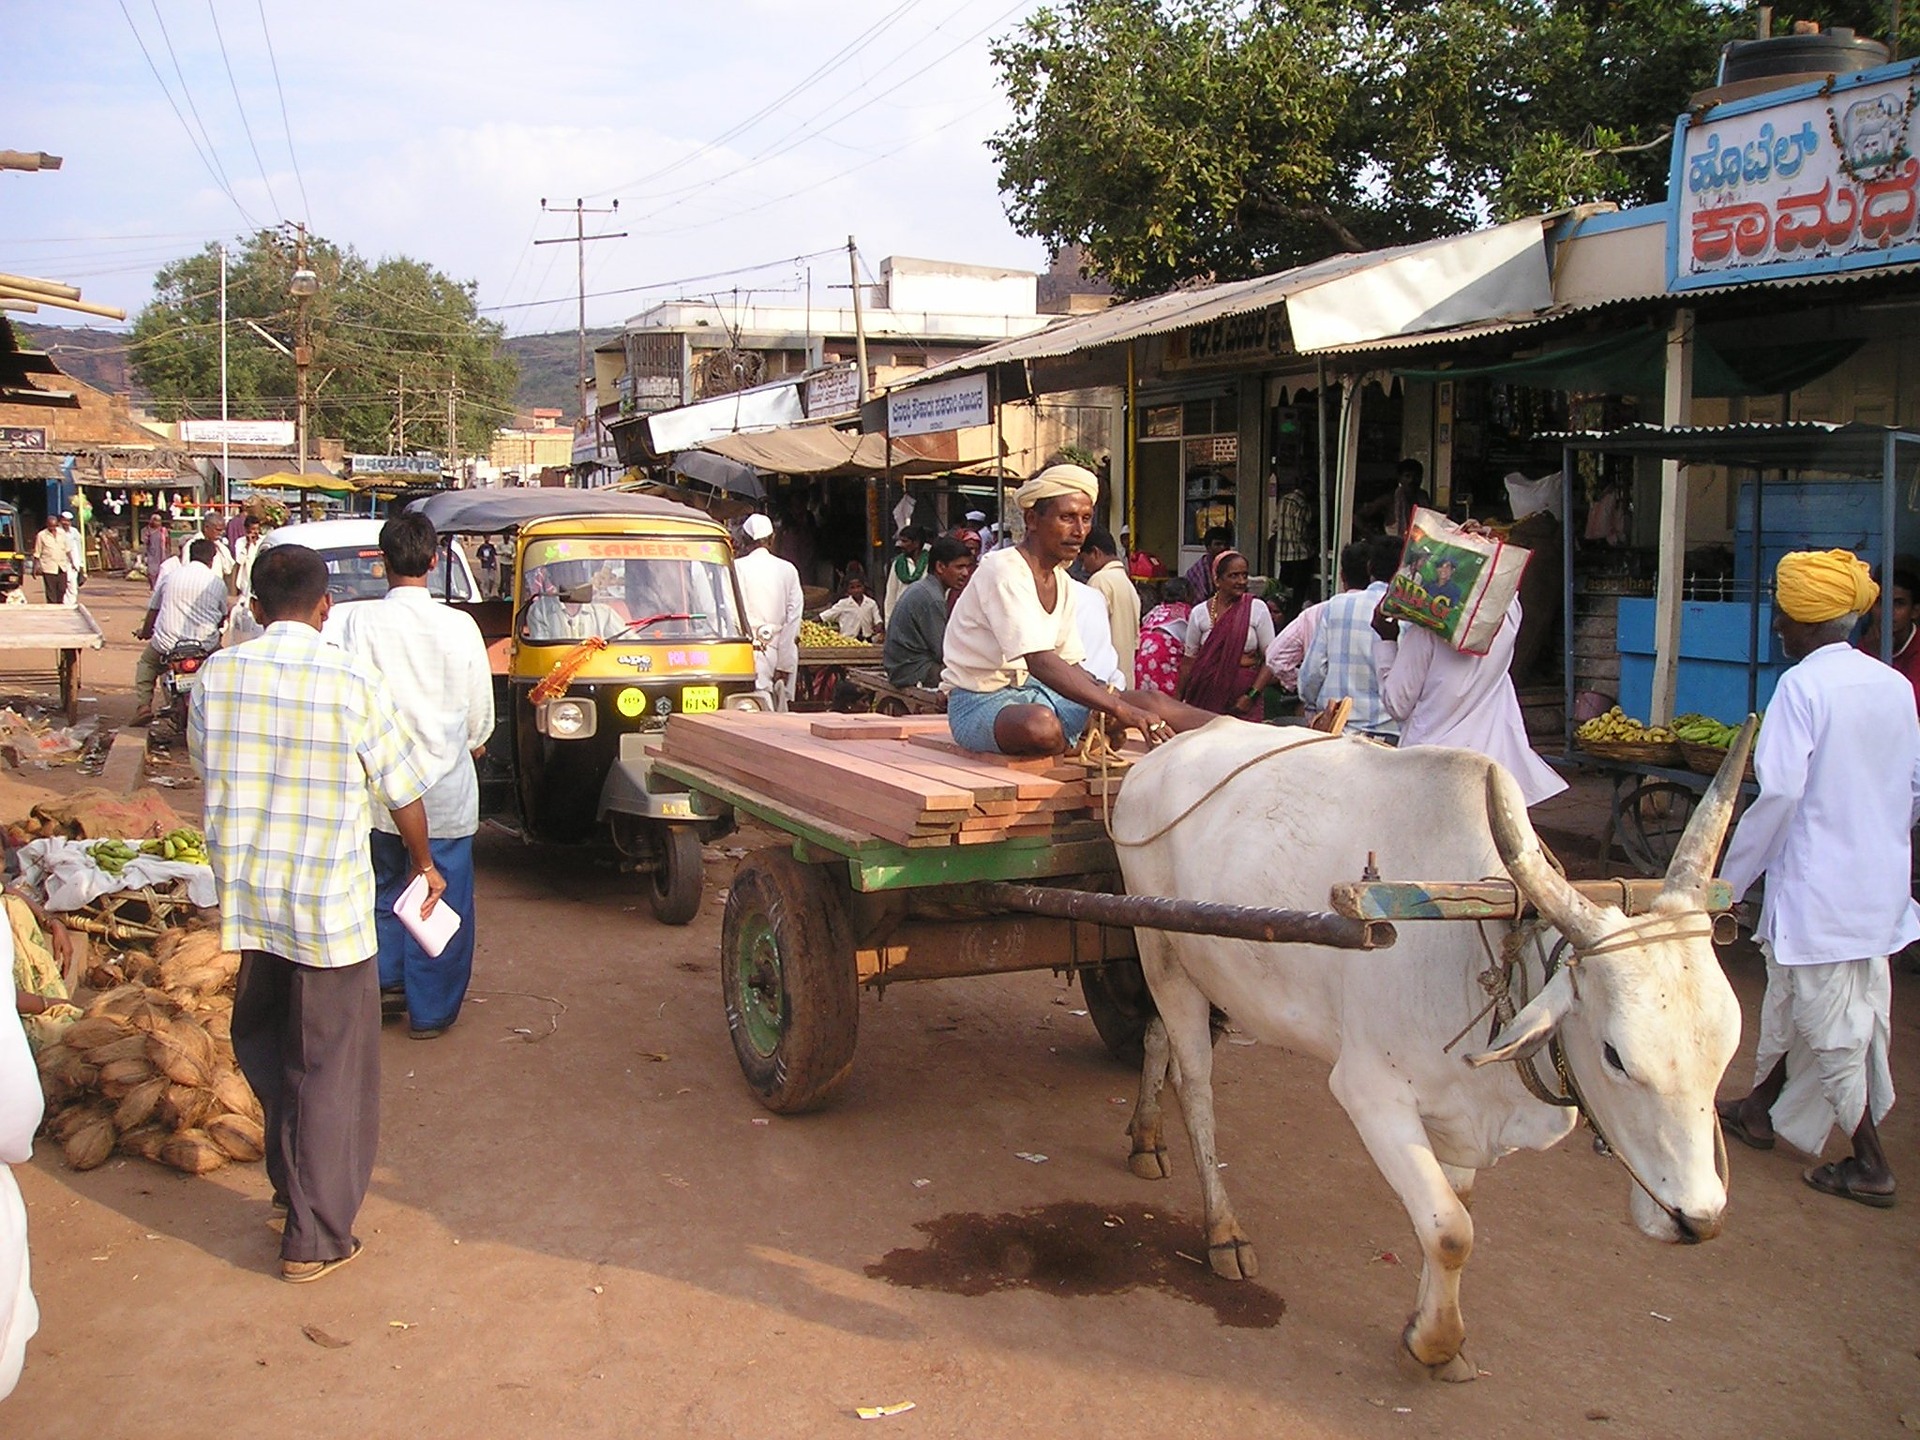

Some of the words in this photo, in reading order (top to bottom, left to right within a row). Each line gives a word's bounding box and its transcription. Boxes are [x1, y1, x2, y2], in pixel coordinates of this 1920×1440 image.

[588, 543, 689, 557] SAMEER
[685, 698, 716, 710] 6183
[662, 803, 676, 814] KA
